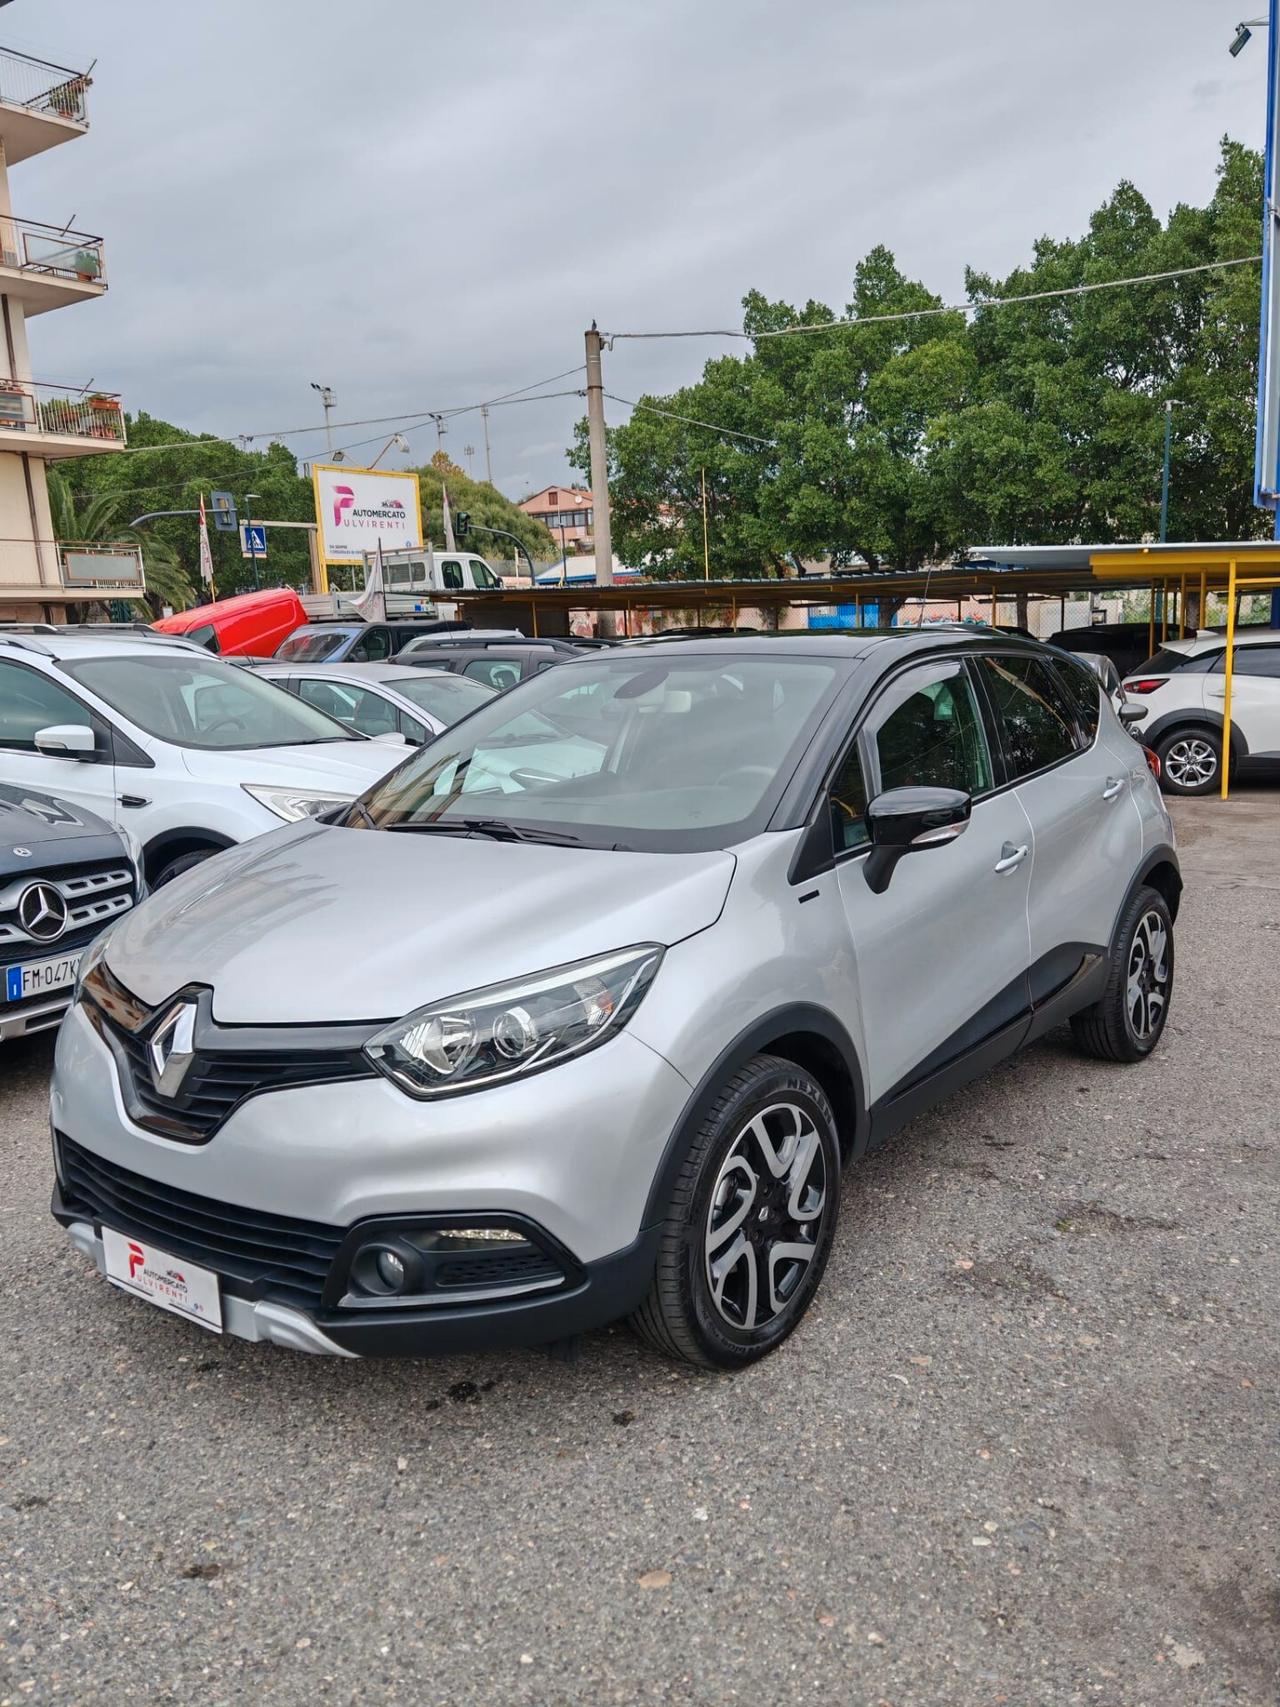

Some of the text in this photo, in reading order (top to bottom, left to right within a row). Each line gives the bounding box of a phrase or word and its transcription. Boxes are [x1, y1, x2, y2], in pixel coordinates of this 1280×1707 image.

[352, 509, 406, 519] AUTOMERCATO
[786, 1079, 833, 1125] NEXEN
[143, 1269, 188, 1294] AUTOMERCATO
